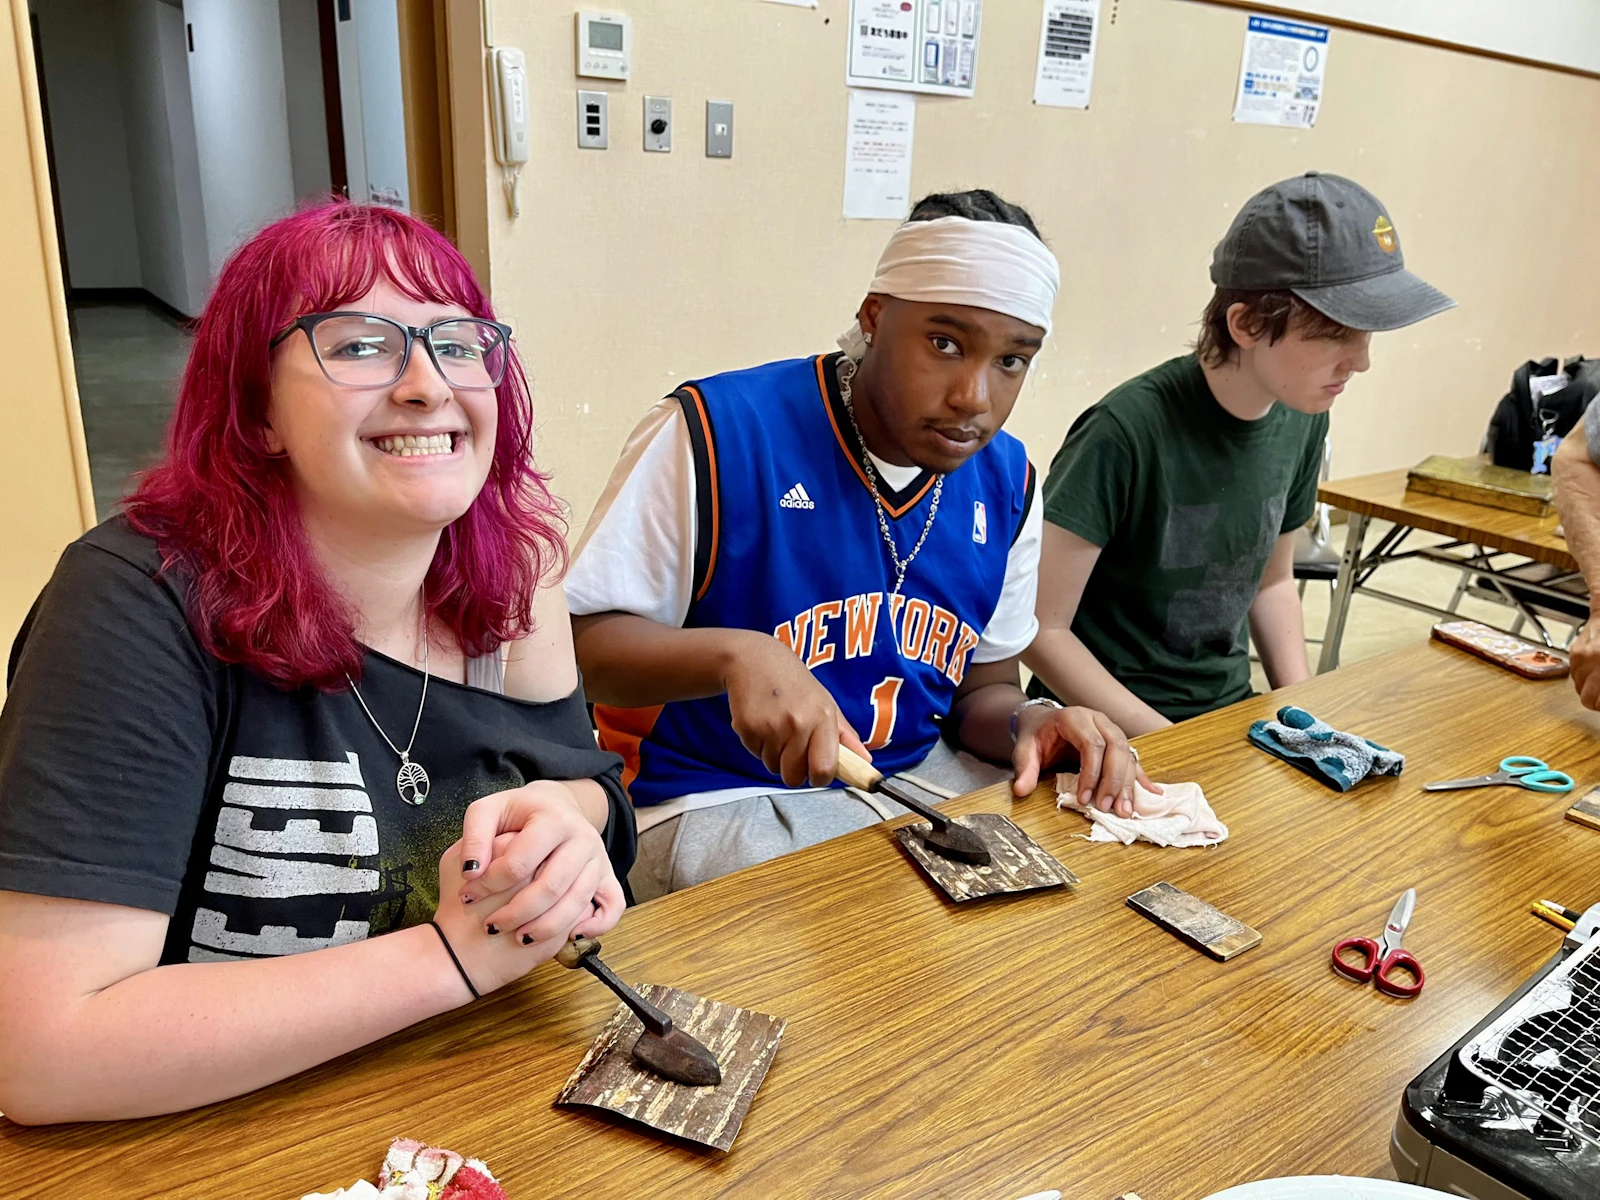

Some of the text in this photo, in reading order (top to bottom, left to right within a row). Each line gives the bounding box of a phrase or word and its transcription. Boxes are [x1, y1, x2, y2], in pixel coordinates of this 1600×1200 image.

[779, 498, 815, 510] adidas
[774, 591, 883, 670] NEW
[863, 676, 905, 751] 1
[203, 750, 380, 899] VEIL
